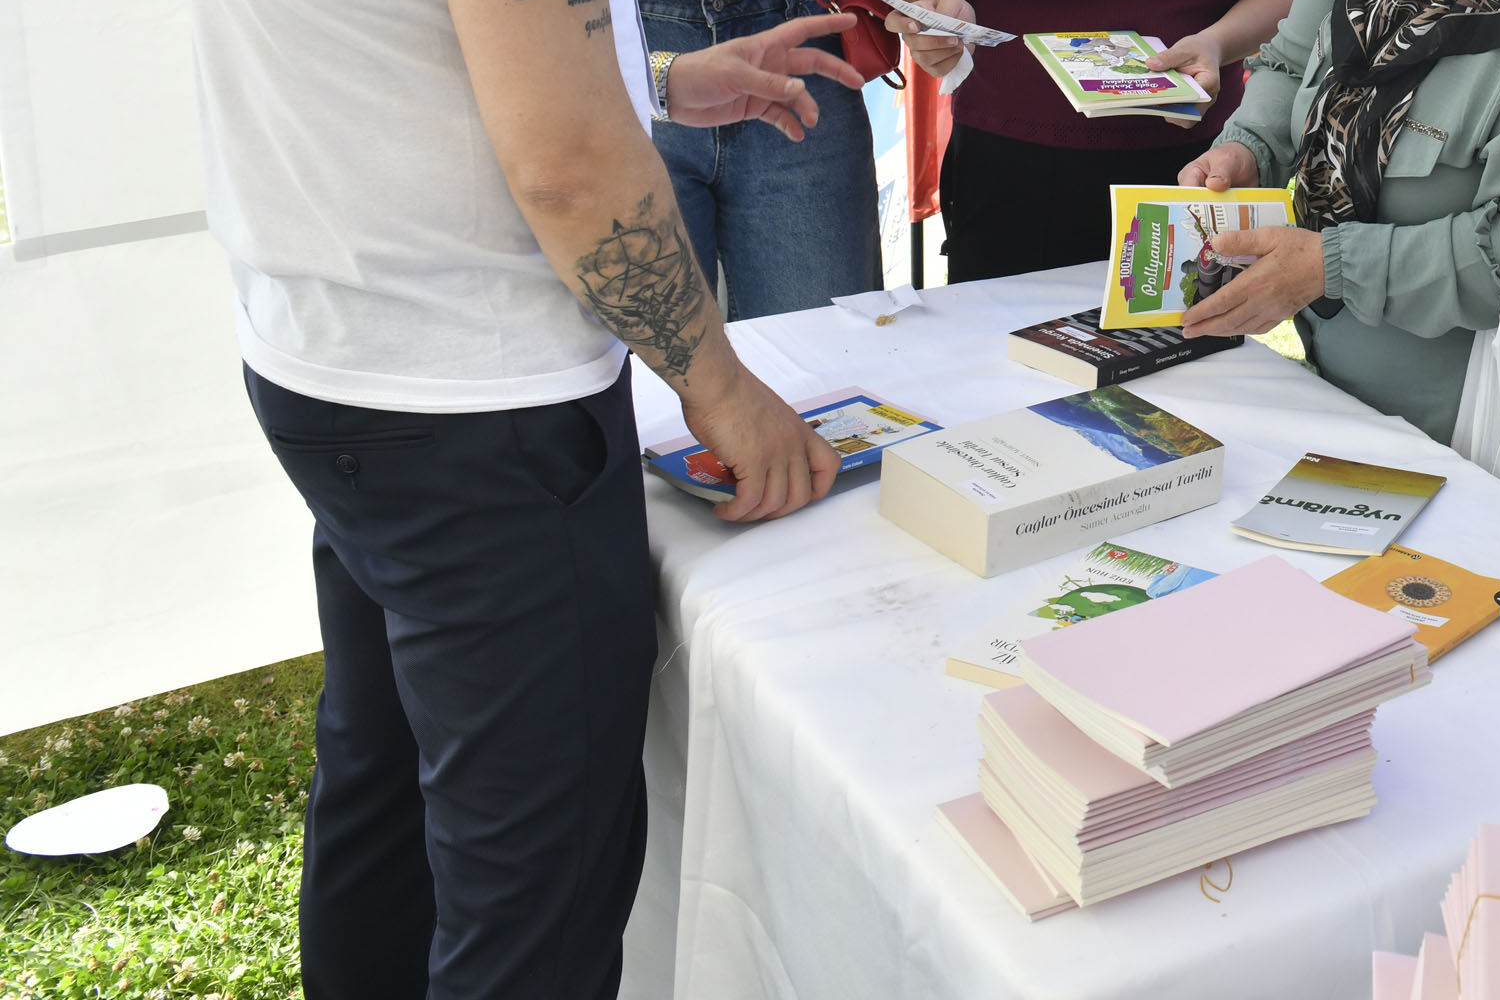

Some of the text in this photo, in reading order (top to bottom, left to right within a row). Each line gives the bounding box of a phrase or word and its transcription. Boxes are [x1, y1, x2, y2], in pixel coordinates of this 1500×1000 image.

[1140, 222, 1164, 296] Pollyanna
[1120, 262, 1131, 279] 100
[1038, 327, 1068, 344] Kurgu
[1067, 336, 1116, 359] Sinemada
[1064, 491, 1130, 522] Öncesinde
[1132, 479, 1173, 502] Sarsat
[1176, 465, 1213, 488] Tarihi
[1086, 567, 1110, 578] HUN
